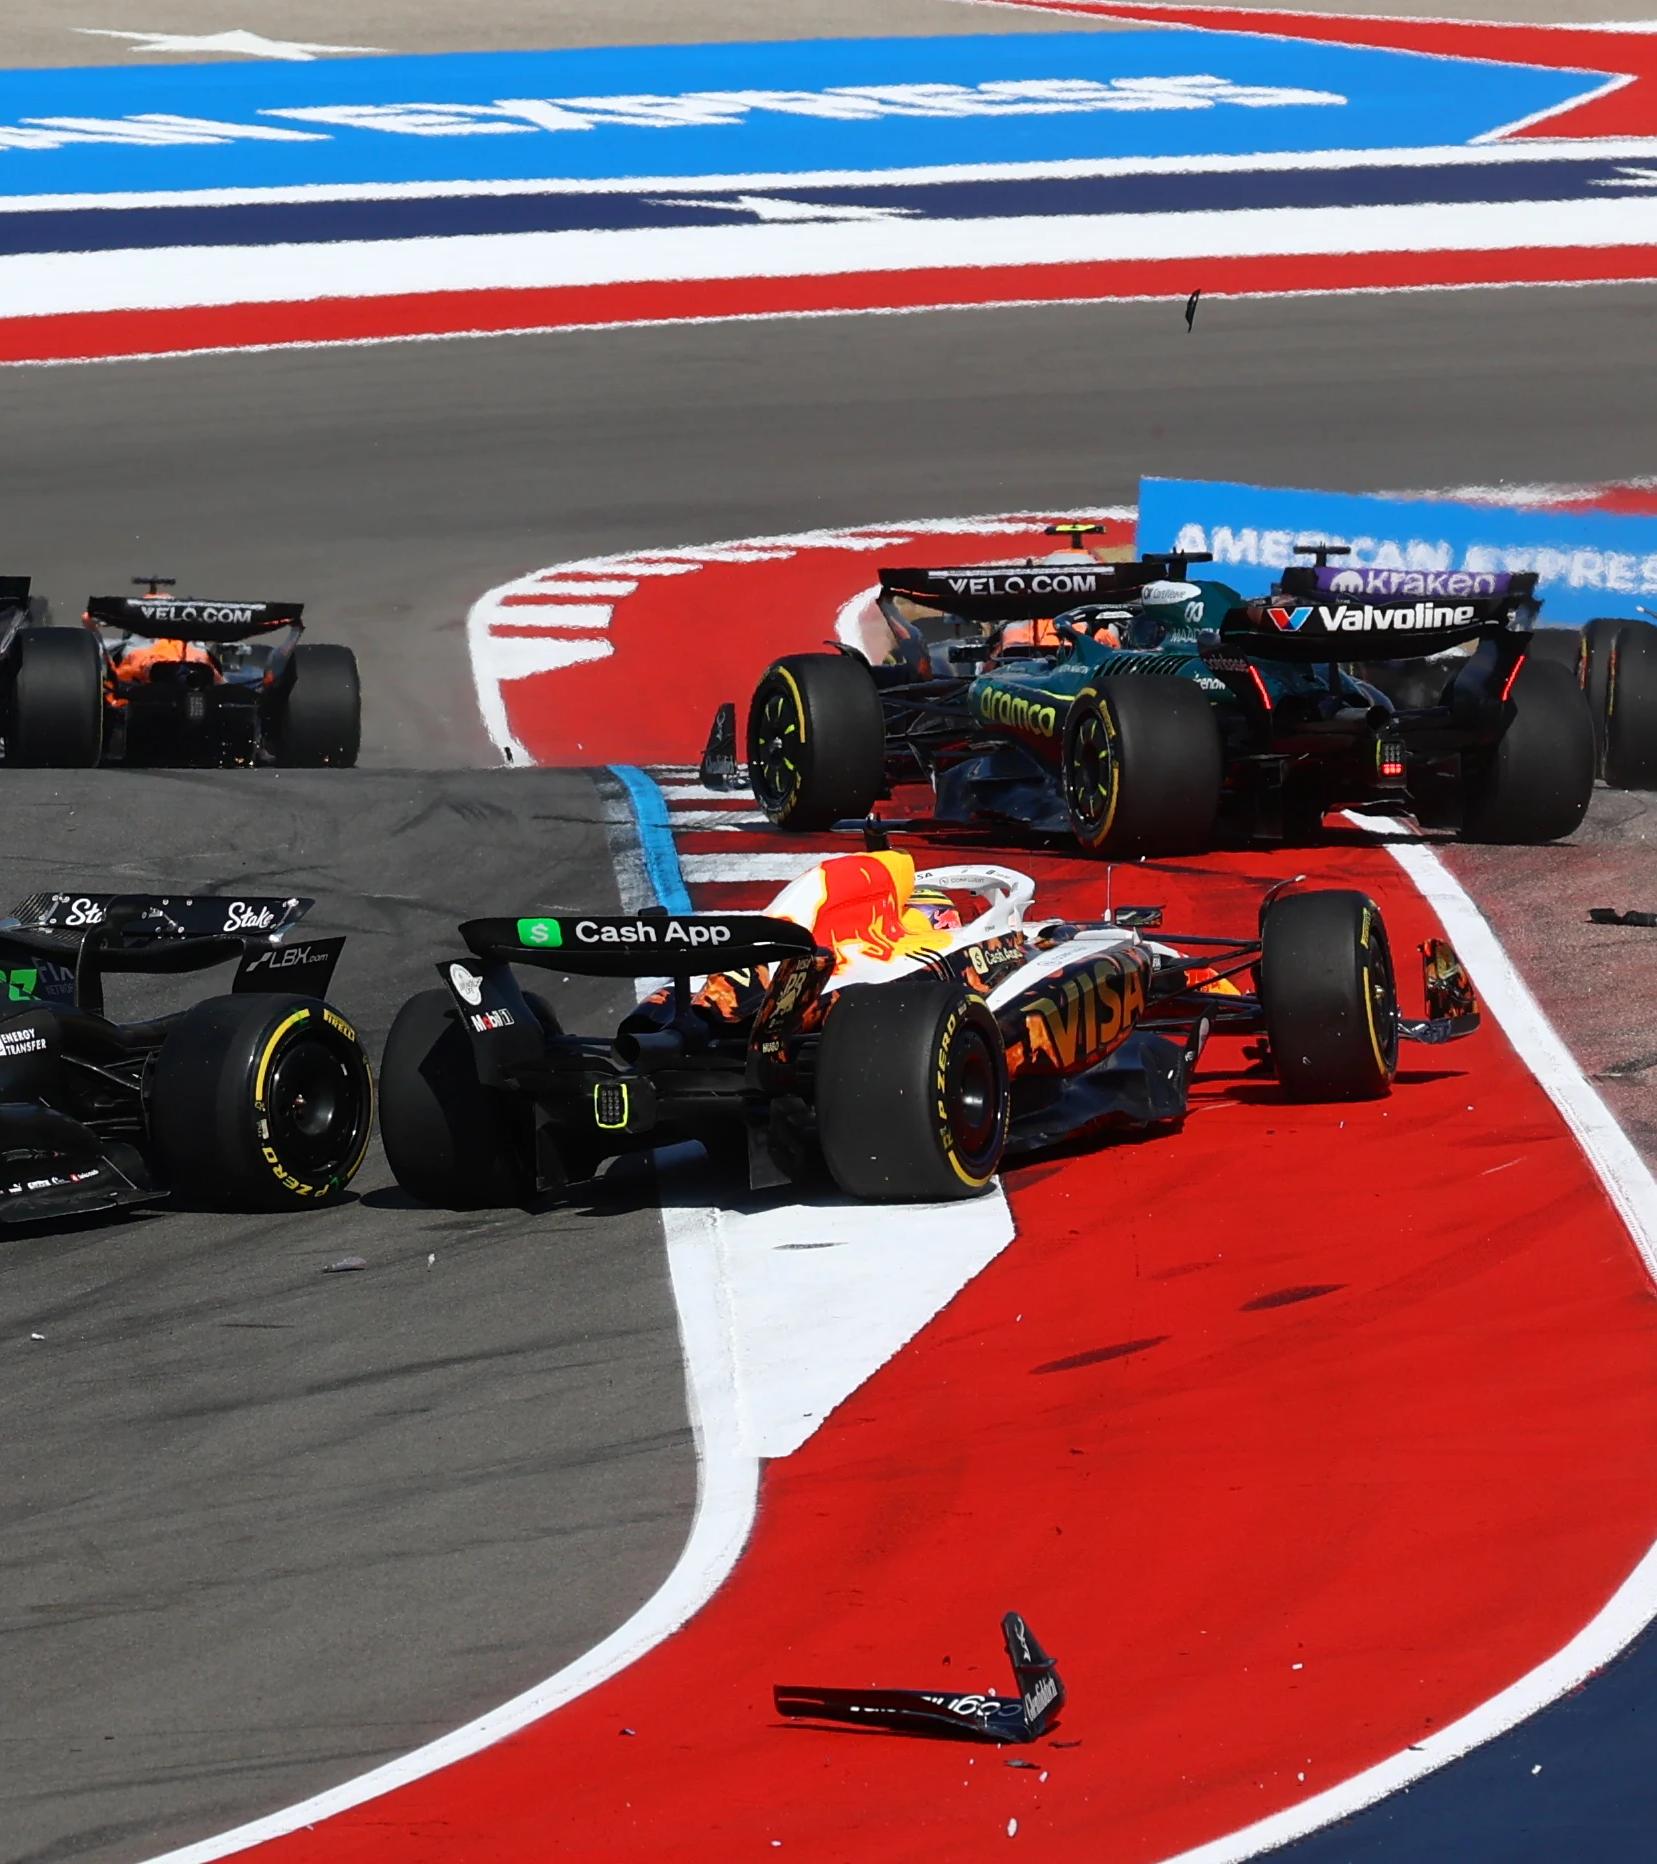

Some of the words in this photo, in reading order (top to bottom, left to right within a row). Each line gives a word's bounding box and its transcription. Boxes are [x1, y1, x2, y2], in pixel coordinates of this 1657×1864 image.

[255, 74, 1348, 137] EXPRESS
[948, 575, 1097, 596] VELO.COM
[140, 605, 254, 626] VELO.COM
[1318, 602, 1475, 631] Valvoline
[980, 686, 1056, 737] aramco
[65, 897, 106, 926] Sta
[223, 901, 276, 932] Stake
[575, 918, 657, 944] Cash
[663, 921, 732, 947] App
[270, 946, 329, 970] LBX.com
[323, 1008, 356, 1042] PIRELLI
[470, 1011, 503, 1032] Mobil
[1020, 956, 1144, 1067] VISA
[0, 1028, 35, 1043] ENERGY
[5, 1038, 47, 1056] TRANSFER
